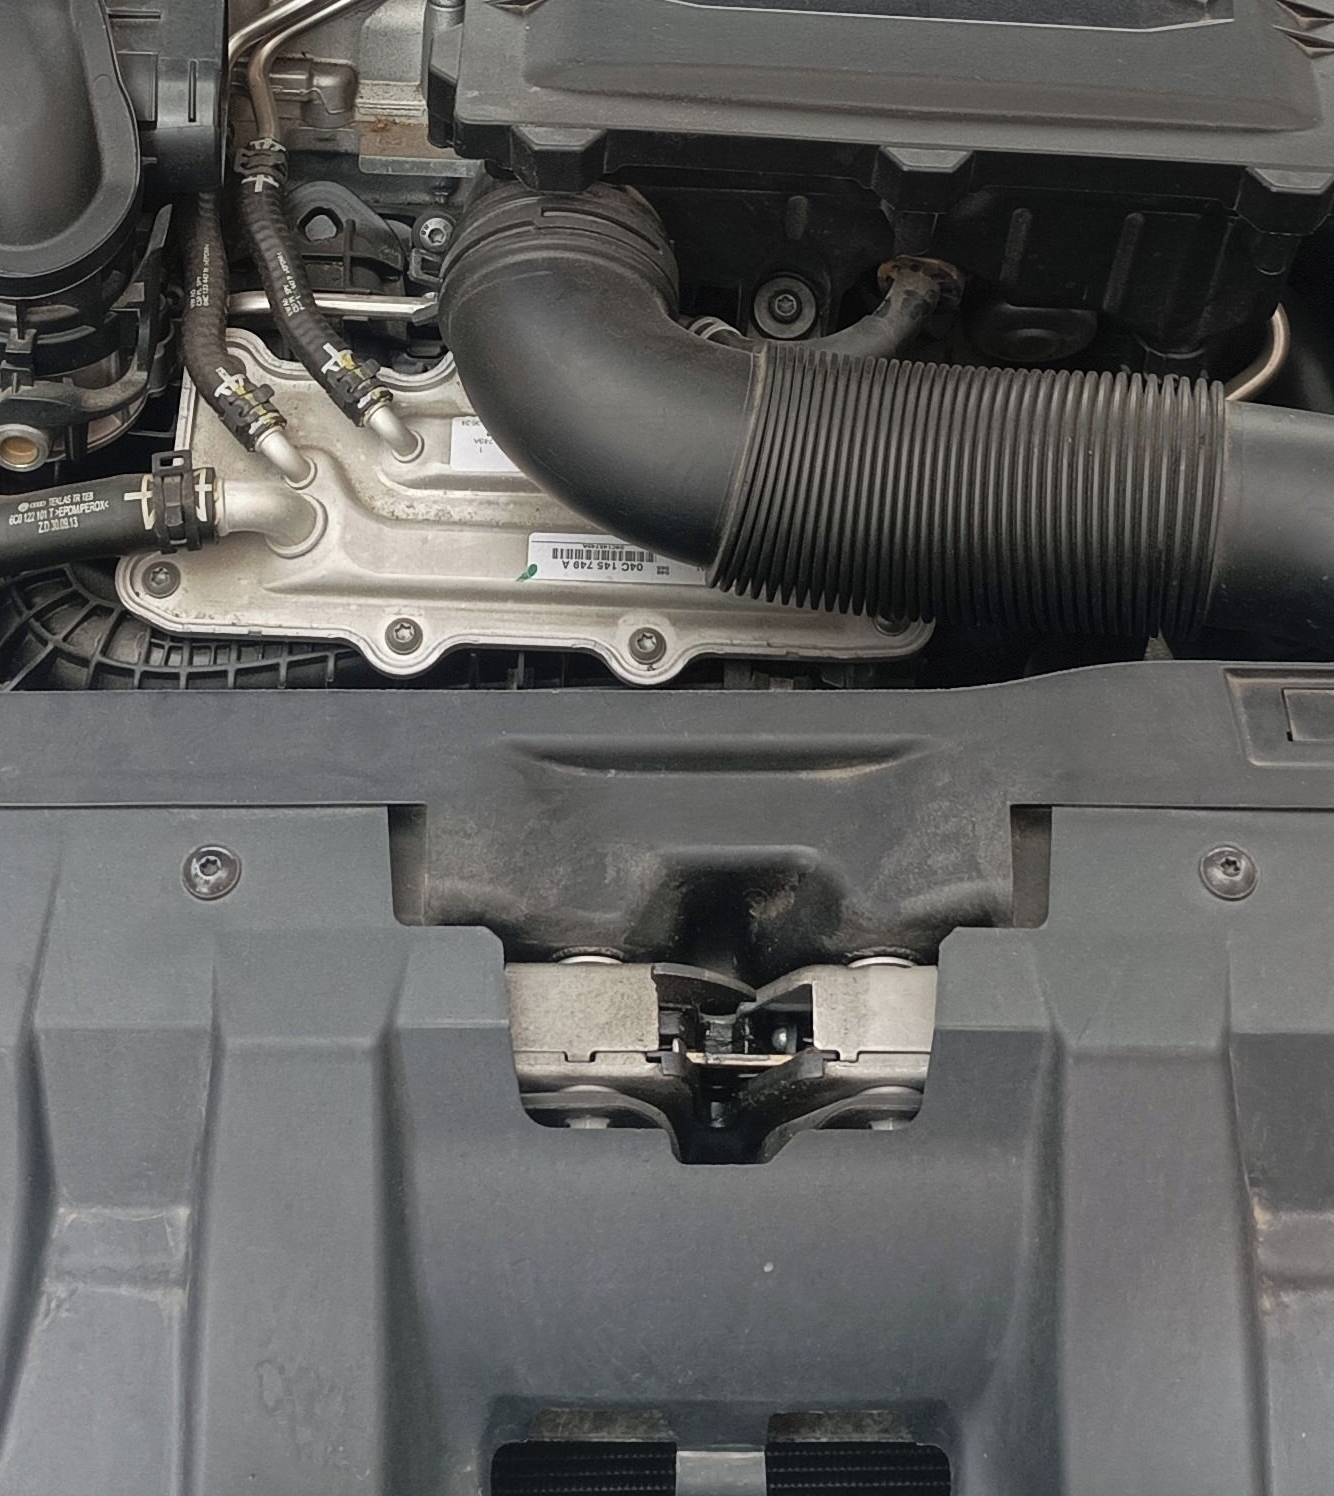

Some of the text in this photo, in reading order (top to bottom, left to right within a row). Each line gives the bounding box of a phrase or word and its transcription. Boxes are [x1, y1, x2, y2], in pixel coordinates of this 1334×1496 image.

[561, 559, 642, 571] 04C 145 749 A
